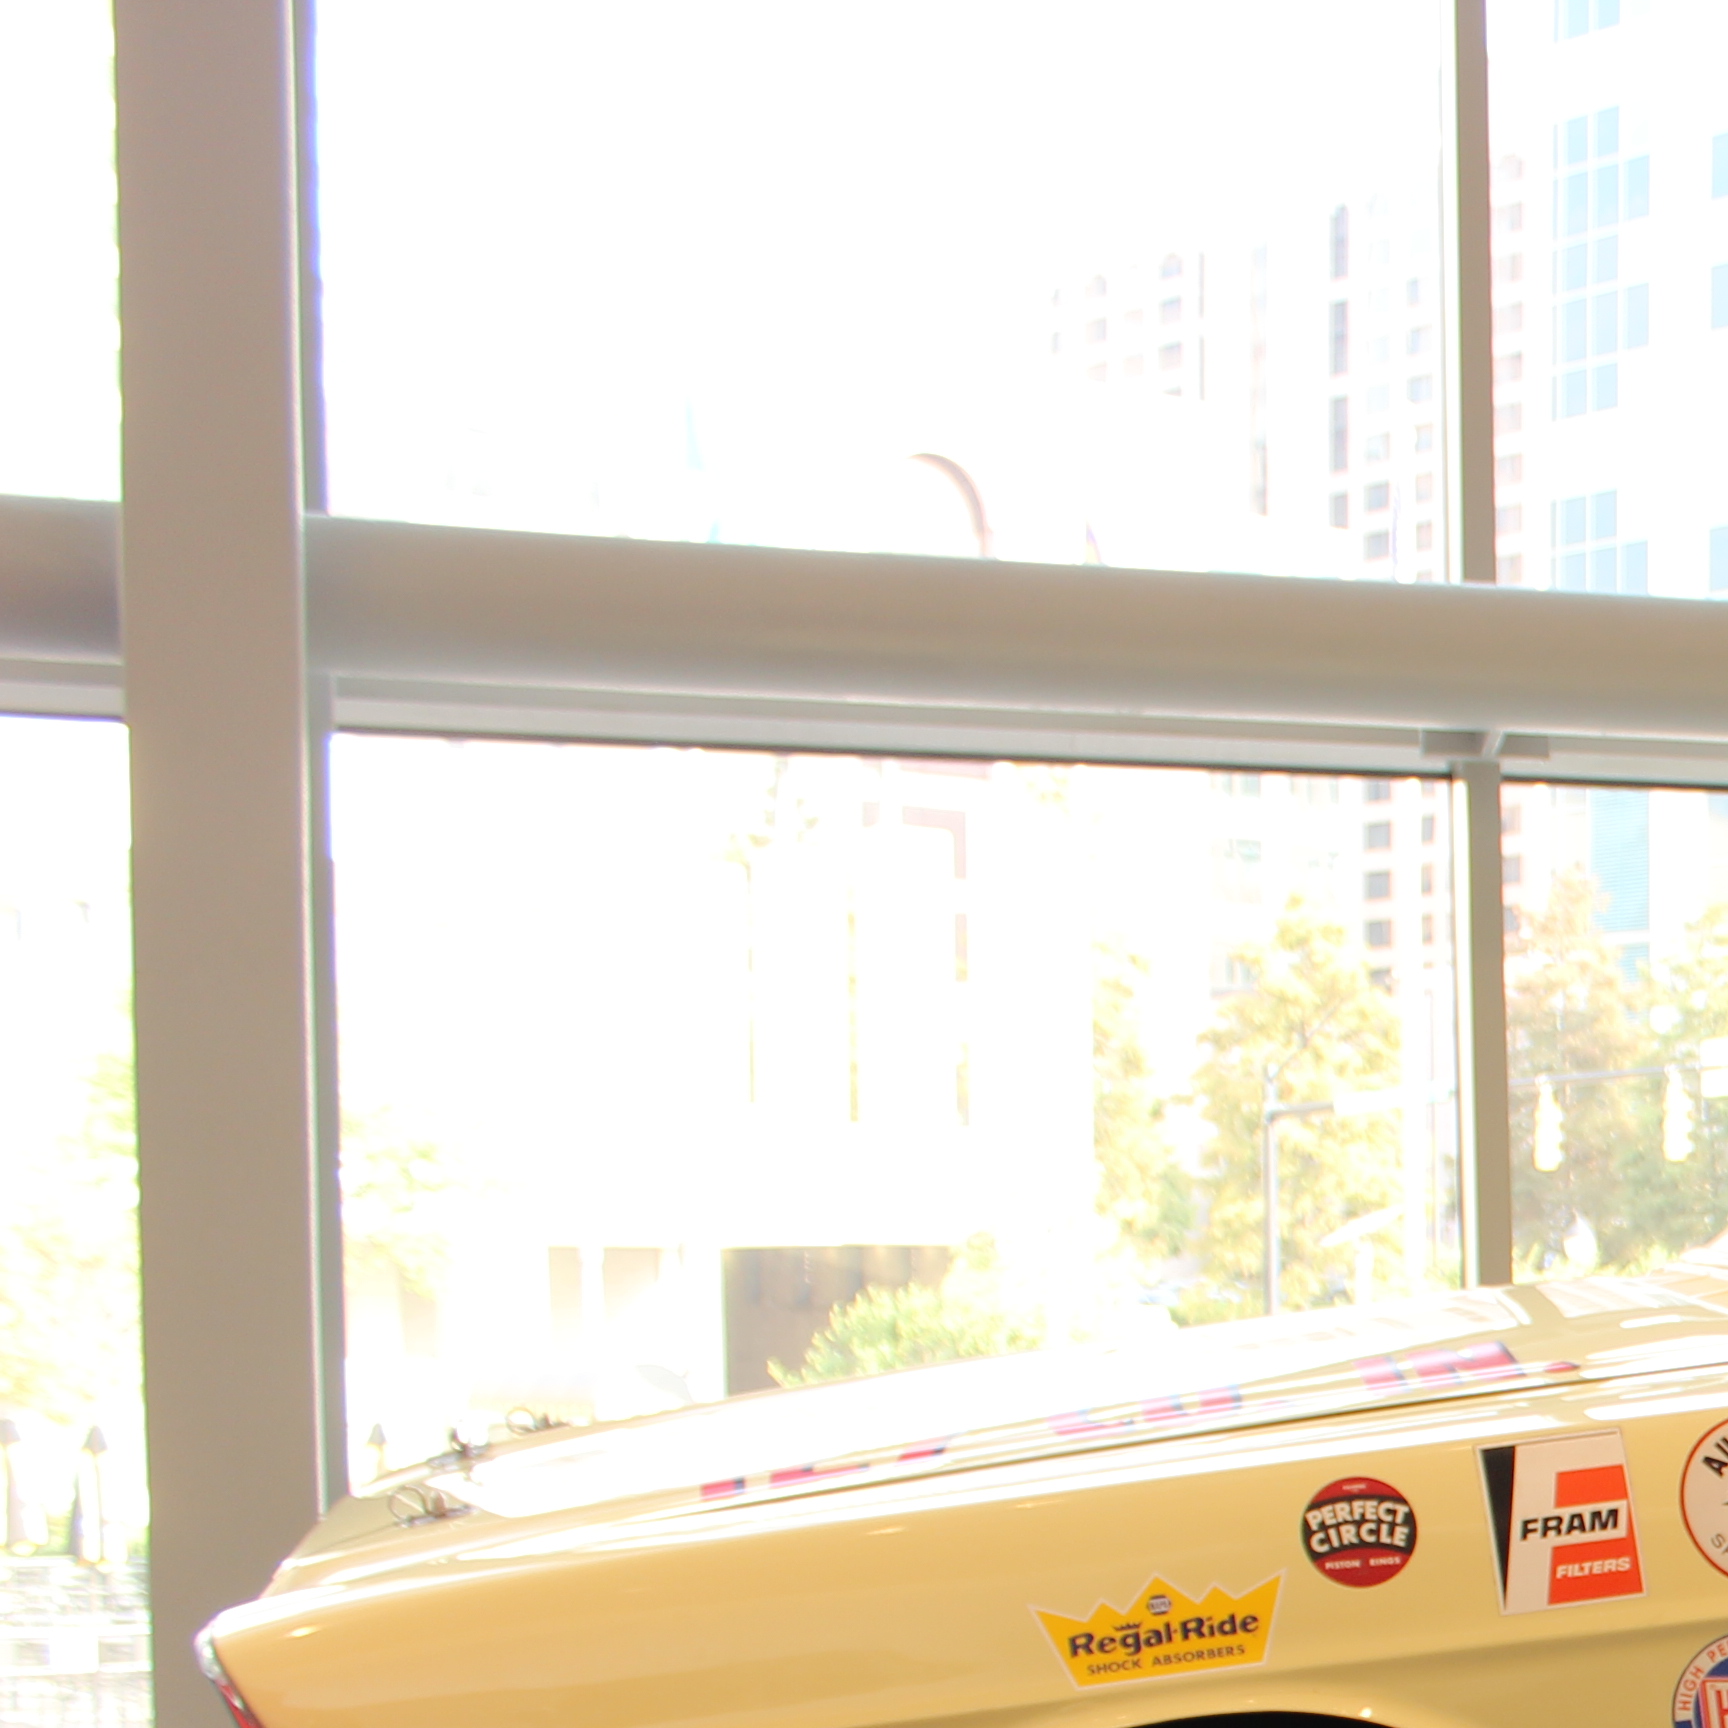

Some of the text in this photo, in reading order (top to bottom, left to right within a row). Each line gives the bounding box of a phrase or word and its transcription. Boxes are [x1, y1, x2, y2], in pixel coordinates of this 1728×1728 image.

[1305, 1499, 1410, 1531] PERFECT
[1520, 1508, 1618, 1541] FRAM
[1310, 1521, 1409, 1553] CIRCLE
[1325, 1557, 1401, 1570] PISTON RINGS
[1556, 1556, 1631, 1579] FILTERS
[1087, 1645, 1246, 1676] SHOCK ABSORBERS
[1679, 1667, 1705, 1711] HIGH
